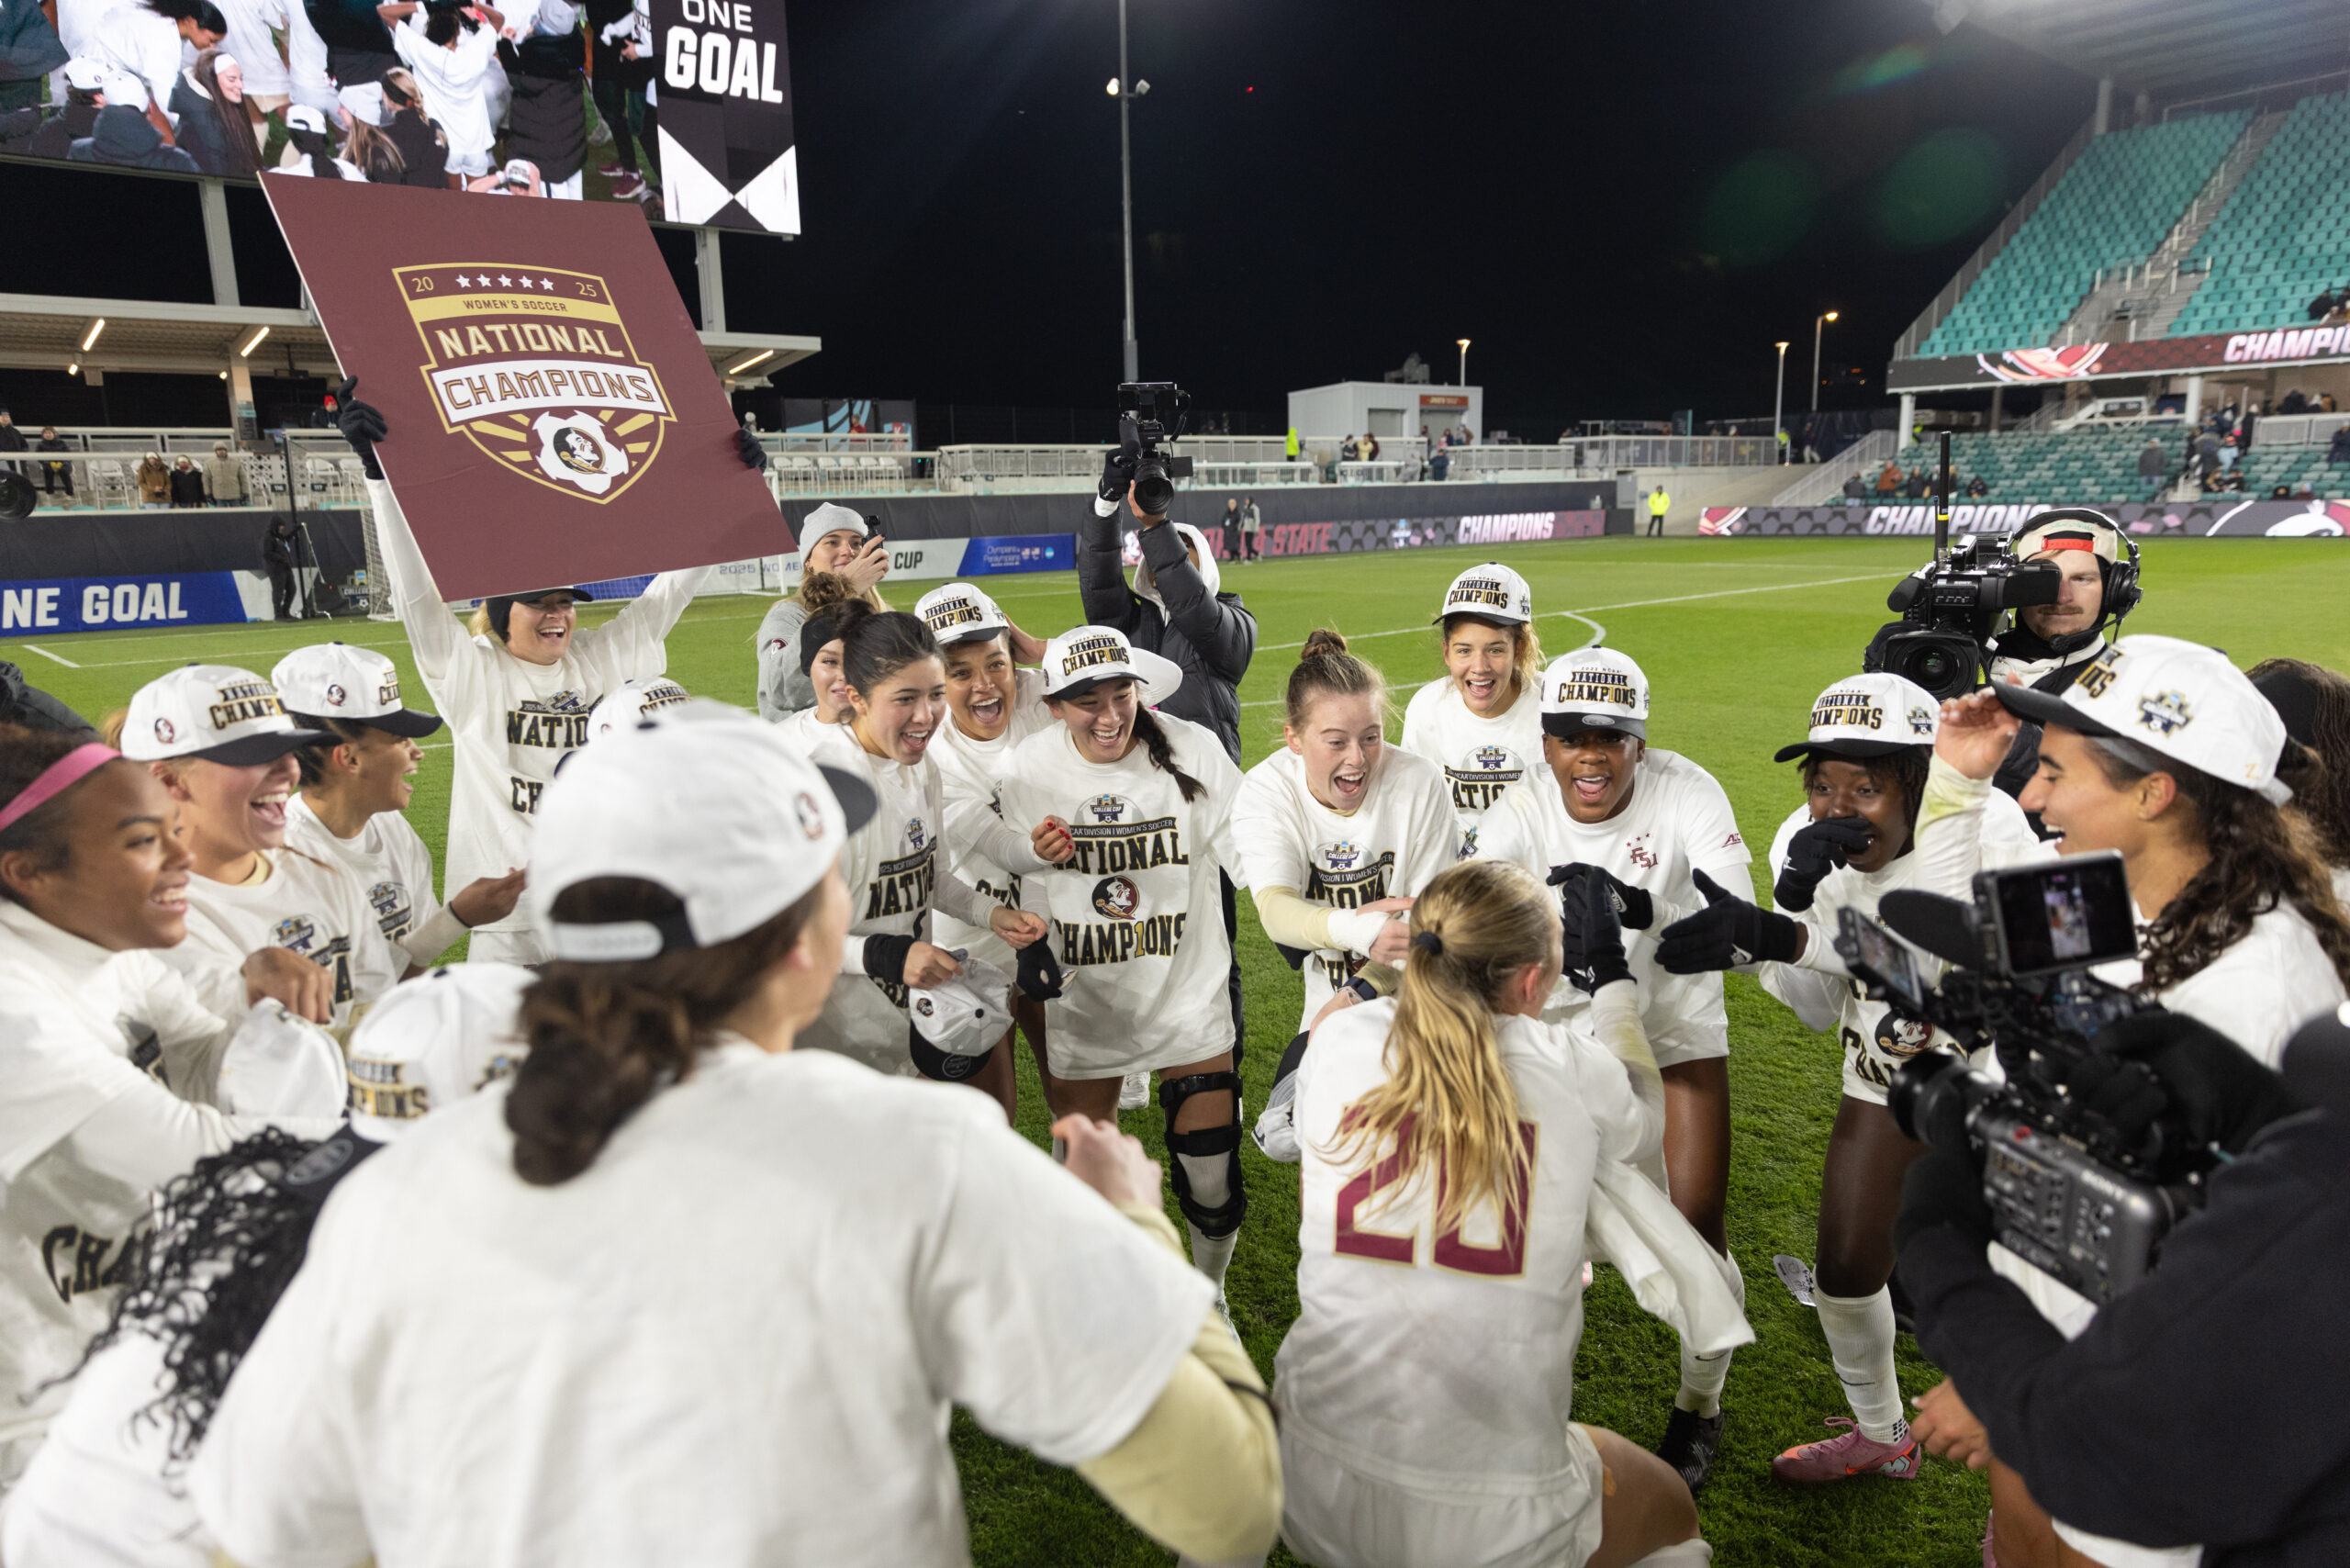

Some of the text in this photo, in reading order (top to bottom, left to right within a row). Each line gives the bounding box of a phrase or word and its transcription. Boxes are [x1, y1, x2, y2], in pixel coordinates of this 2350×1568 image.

[682, 0, 753, 33] ONE
[665, 26, 783, 105] GOAL
[411, 276, 597, 297] 20 25
[463, 299, 568, 312] WOMEN'S SOCCER
[434, 323, 625, 359] NATIONAL
[442, 369, 656, 409] CHAMPIONS
[1272, 523, 1333, 556] STATE
[1458, 511, 1556, 544] CHAMPIONS
[719, 564, 756, 575] 2025
[894, 551, 923, 570] CUP
[1460, 580, 1496, 590] NATIONAL
[2, 582, 188, 629] NE GOAL
[927, 599, 966, 617] NATIONAL
[1072, 638, 1115, 654] NATIONAL
[1574, 672, 1625, 686] NATIONAL
[507, 711, 589, 748] NATIO
[1084, 827, 1111, 835] DIVISION
[1115, 823, 1147, 835] WOMEN'S
[1148, 820, 1173, 831] SOCCER
[1052, 831, 1189, 876] TIONAL
[1318, 872, 1340, 882] VISION
[1332, 1103, 1540, 1280] 20
